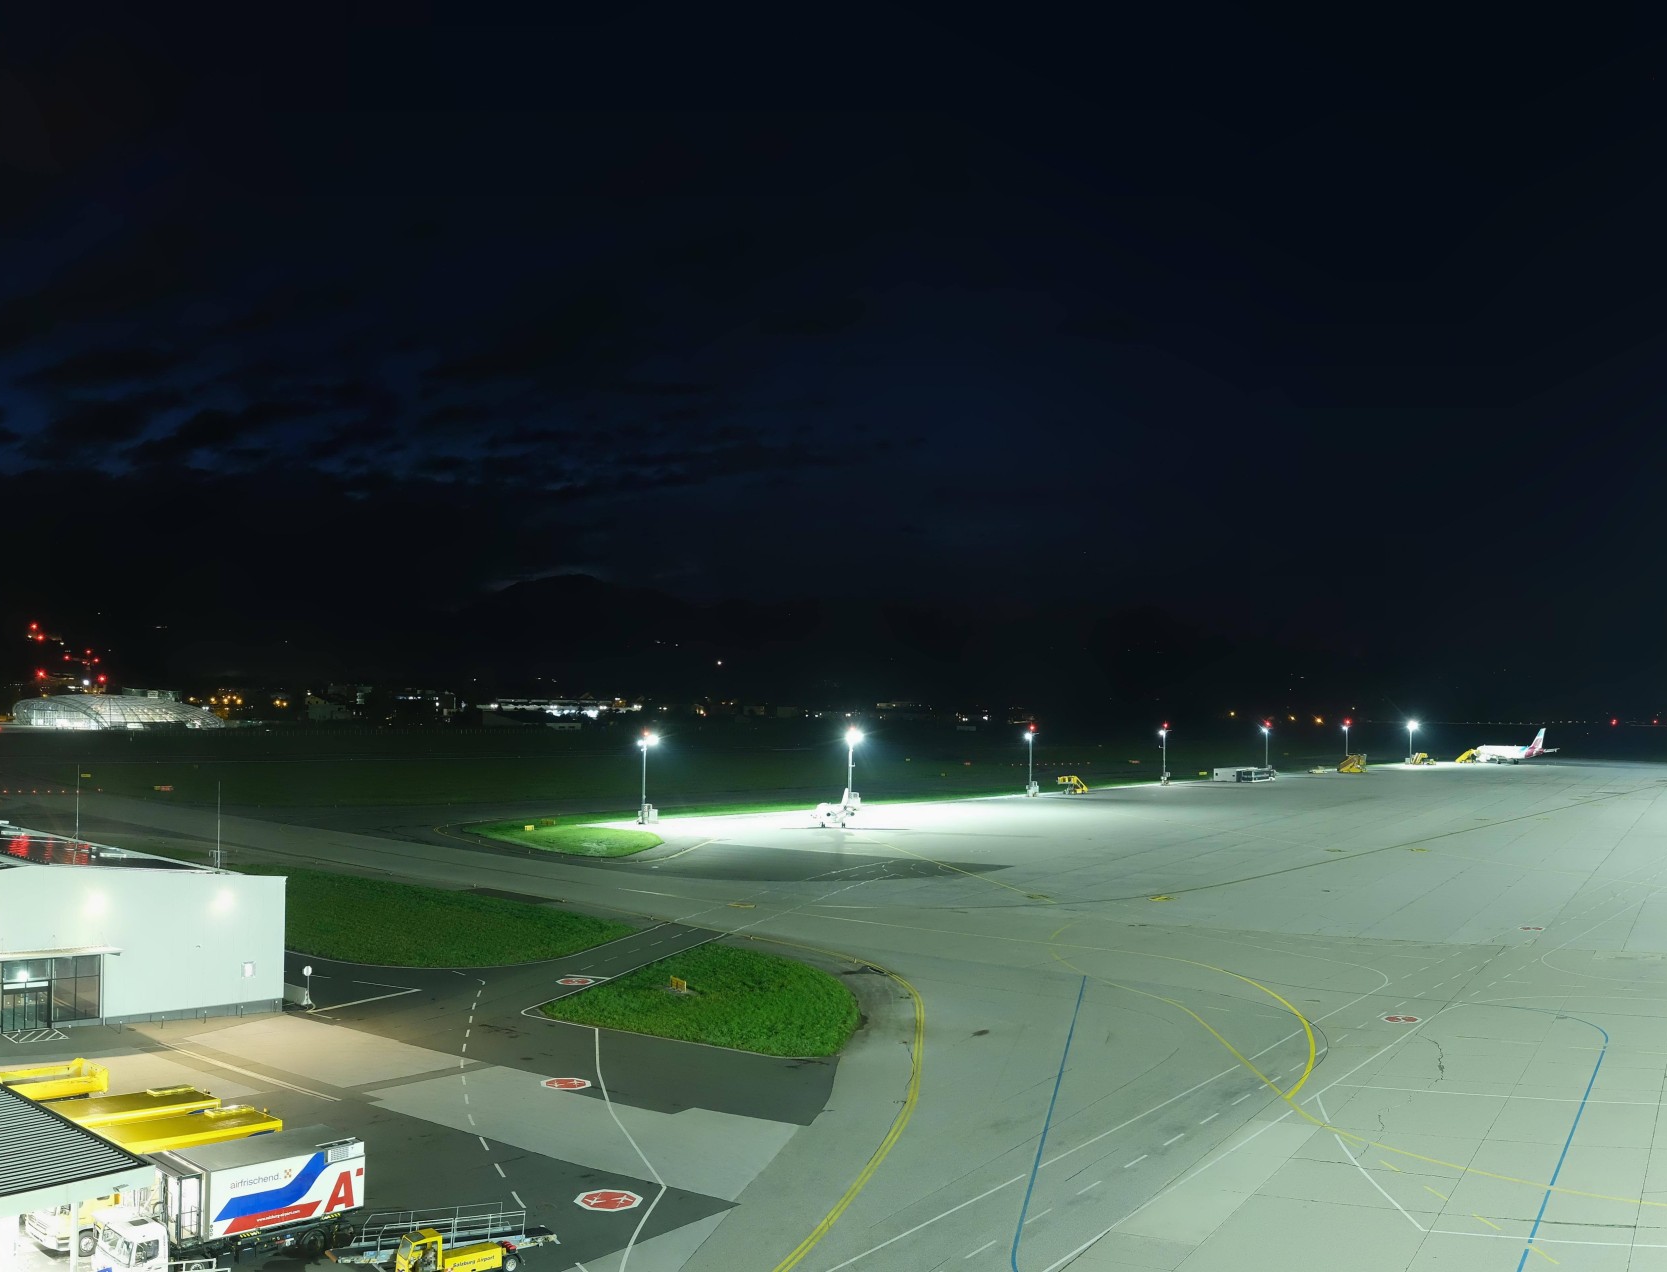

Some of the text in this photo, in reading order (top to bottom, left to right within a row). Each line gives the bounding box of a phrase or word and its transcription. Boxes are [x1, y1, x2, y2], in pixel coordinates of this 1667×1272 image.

[230, 1173, 282, 1189] airfrischend.
[452, 1255, 495, 1268] Salzburg Airport
